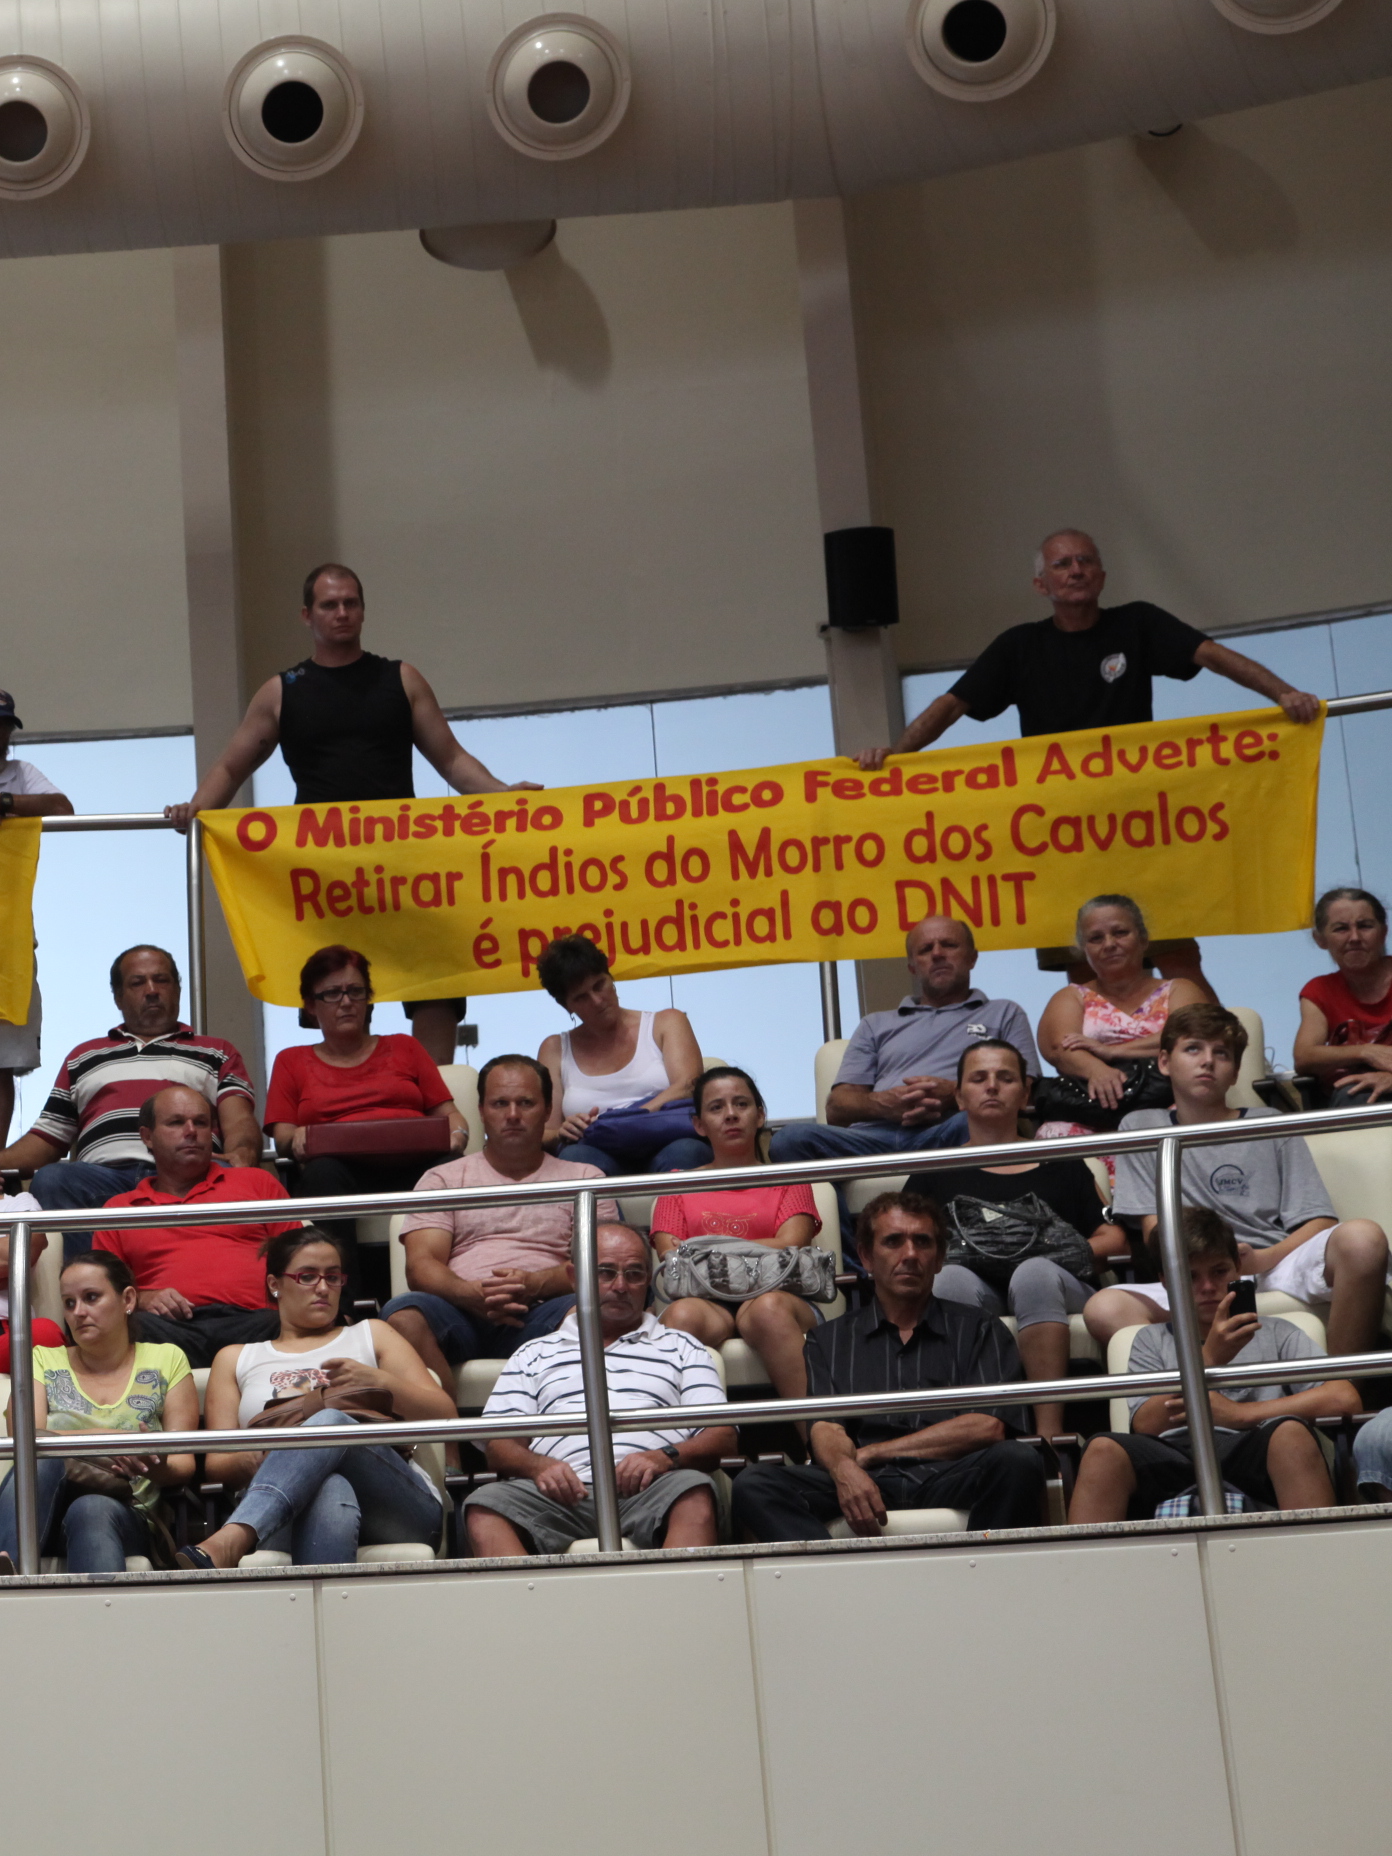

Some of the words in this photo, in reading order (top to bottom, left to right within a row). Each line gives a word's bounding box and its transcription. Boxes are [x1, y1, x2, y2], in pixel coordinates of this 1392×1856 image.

[236, 811, 278, 852] O
[295, 798, 564, 849] Ministério
[582, 776, 785, 828] Público
[803, 746, 1018, 804] Federal
[1036, 724, 1280, 784] Adverte:
[290, 865, 464, 922] Retirar
[480, 838, 629, 903] Índios
[644, 834, 711, 889] do
[727, 826, 886, 881] Morro
[903, 810, 993, 865] dos
[1010, 791, 1230, 857] Cavalos
[473, 917, 502, 970] é
[811, 897, 879, 937] ao
[894, 871, 1036, 932] DNIT
